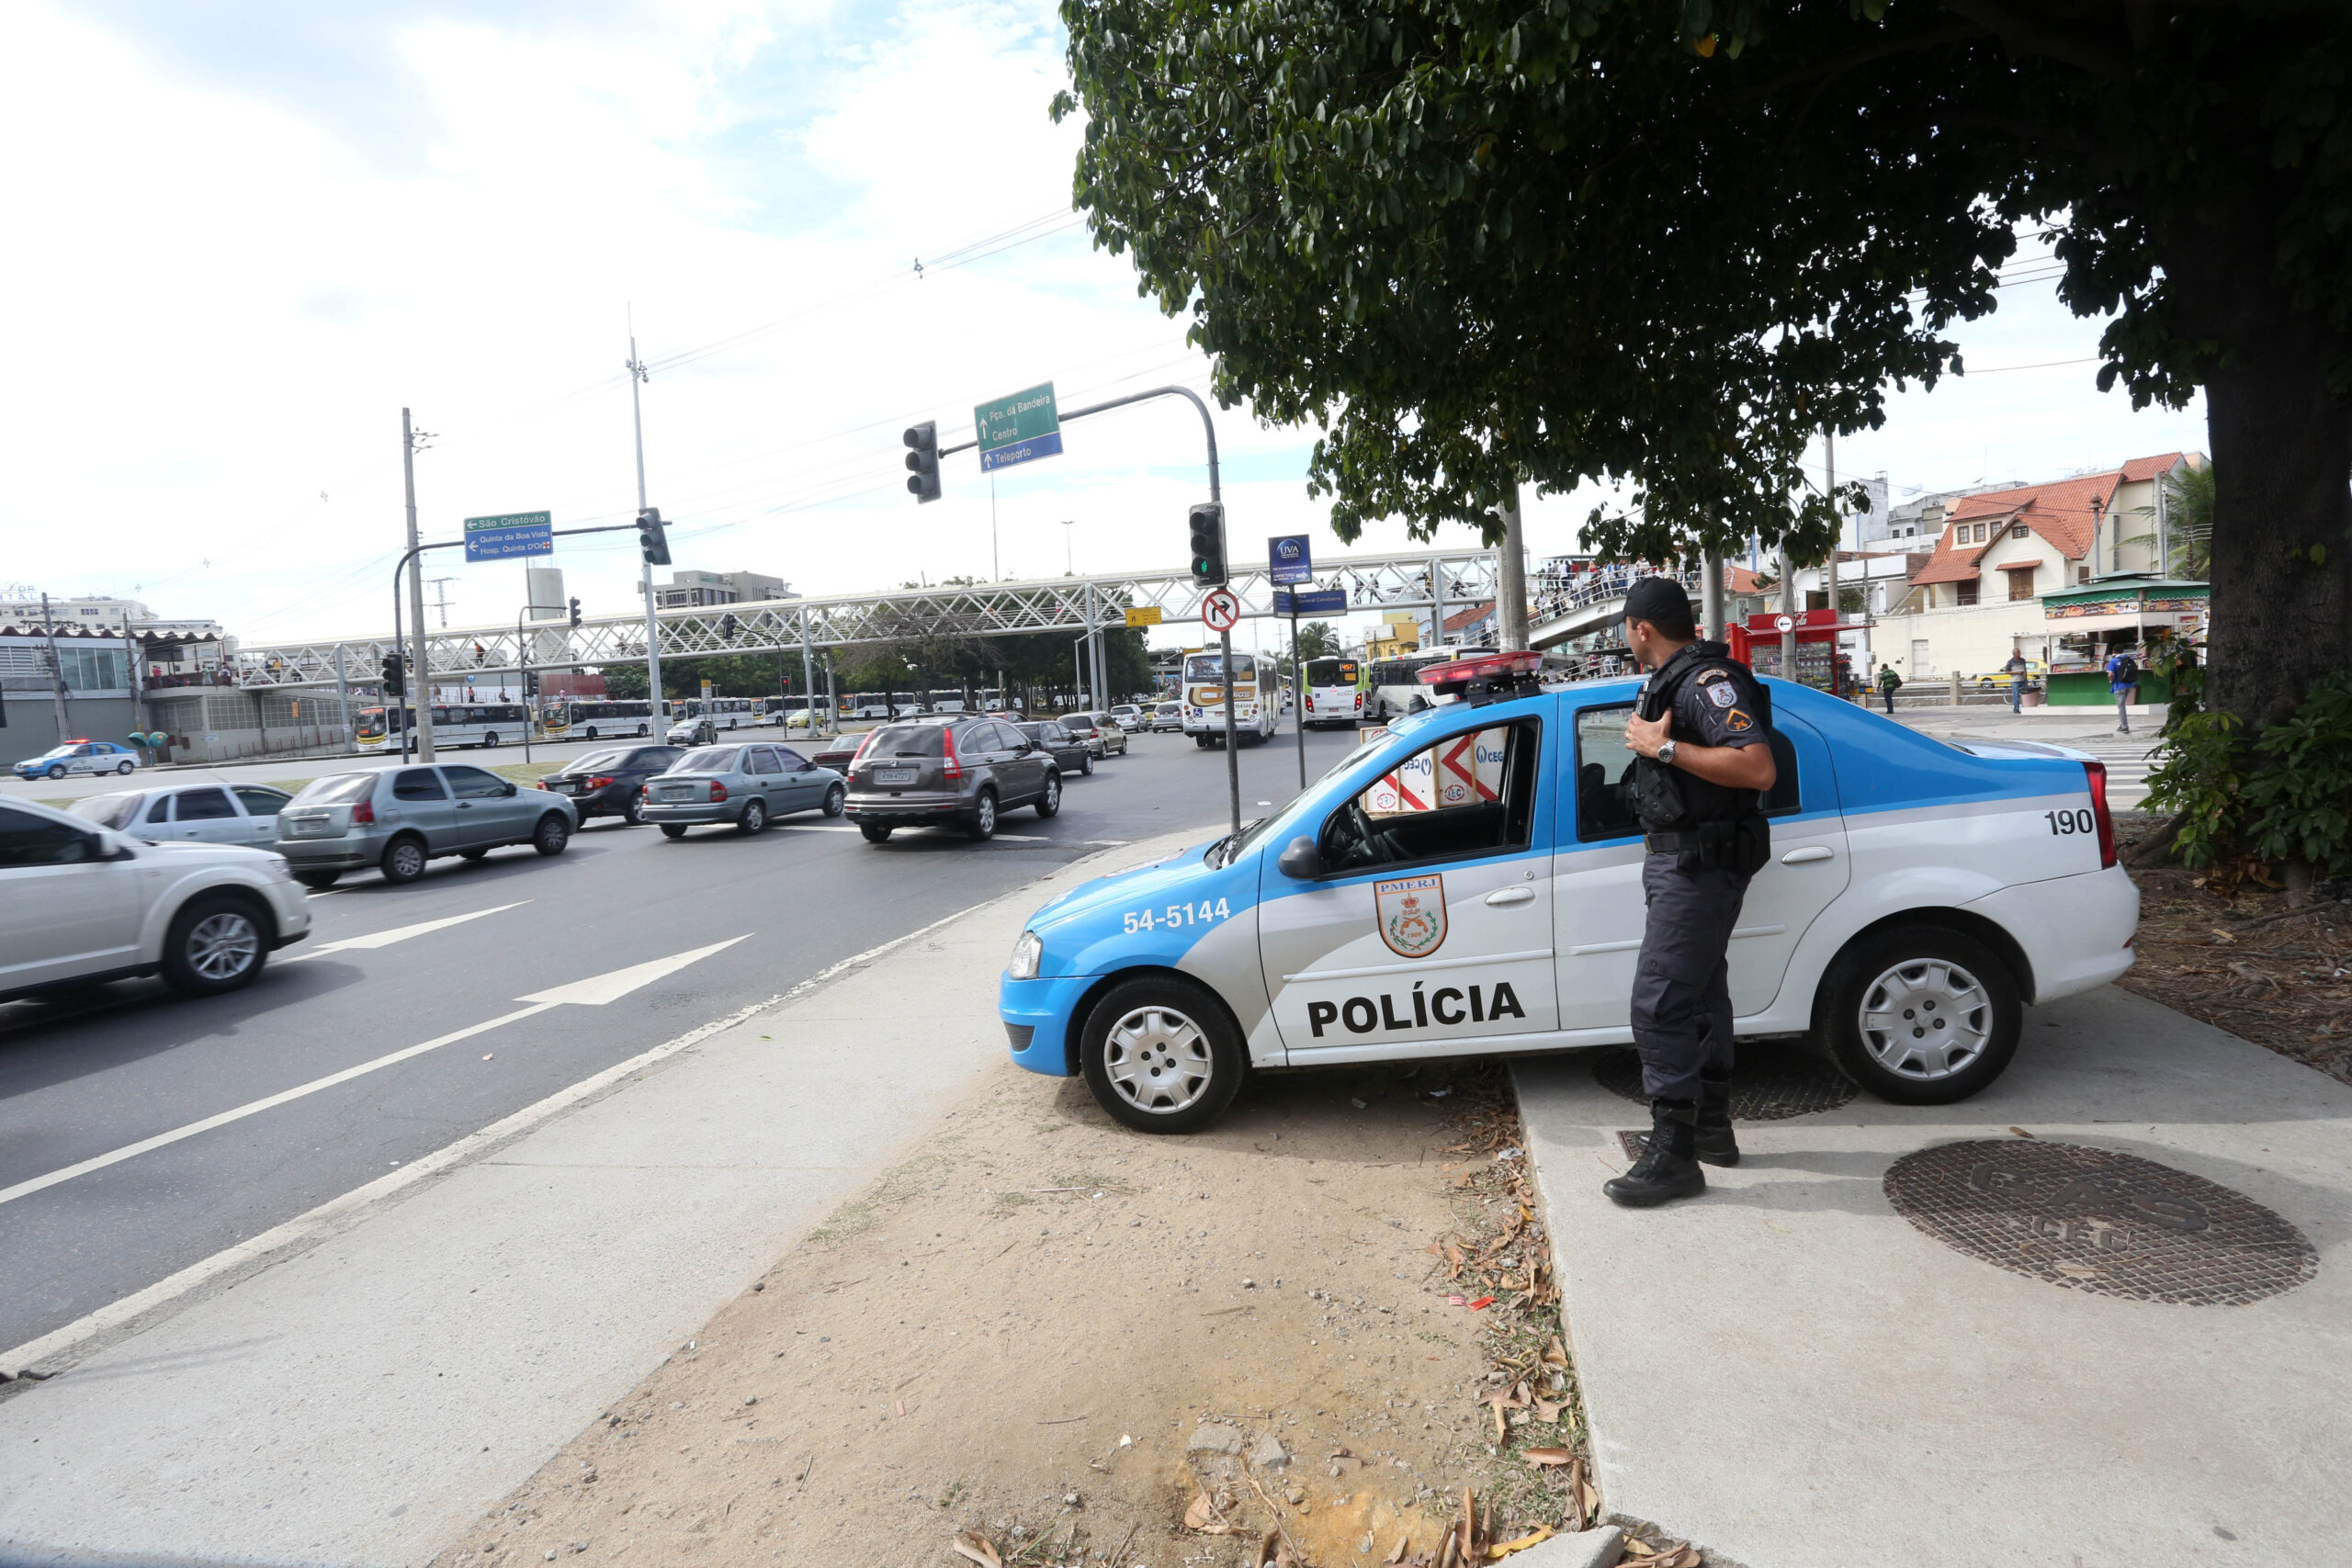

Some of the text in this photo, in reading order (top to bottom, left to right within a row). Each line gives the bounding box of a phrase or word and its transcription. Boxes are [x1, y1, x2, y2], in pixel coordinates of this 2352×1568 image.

[1017, 395, 1051, 412] Bandeira
[992, 427, 1017, 441] Centro
[995, 447, 1032, 464] Teleporto
[479, 515, 546, 528] São Cristóvão
[503, 544, 526, 553] Quinta
[1280, 546, 1299, 554] UVA
[1487, 750, 1505, 762] CEG
[2044, 809, 2093, 835] 190
[1380, 878, 1436, 893] PMERJ
[1124, 897, 1231, 934] 54-5144
[1307, 981, 1526, 1037] POLÍCIA
